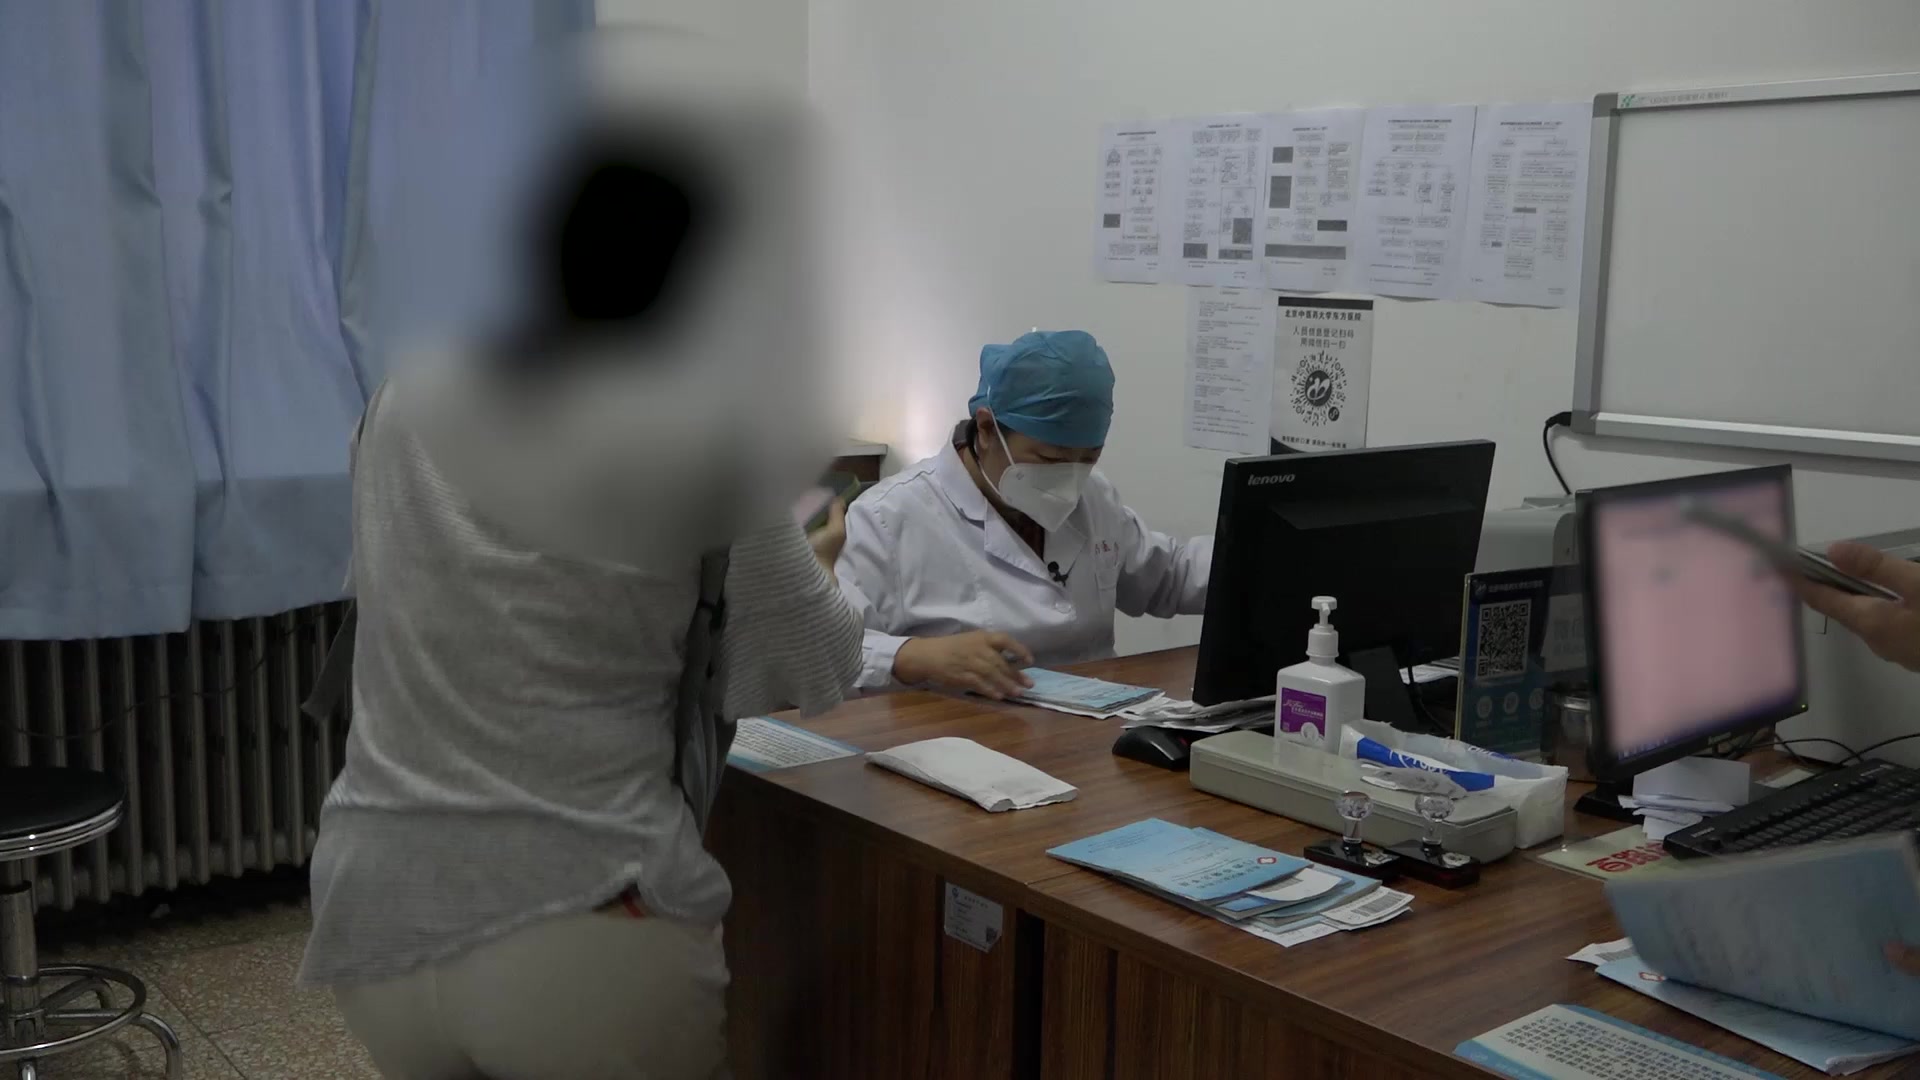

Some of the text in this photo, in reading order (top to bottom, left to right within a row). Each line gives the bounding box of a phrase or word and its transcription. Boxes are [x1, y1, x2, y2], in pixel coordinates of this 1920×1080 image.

[1285, 309, 1362, 321] 北京中医药大学东方医院
[1293, 325, 1354, 339] 人员信息登记扫码
[1300, 337, 1346, 349] 用微信扫一扫
[1247, 473, 1296, 486] lenovo
